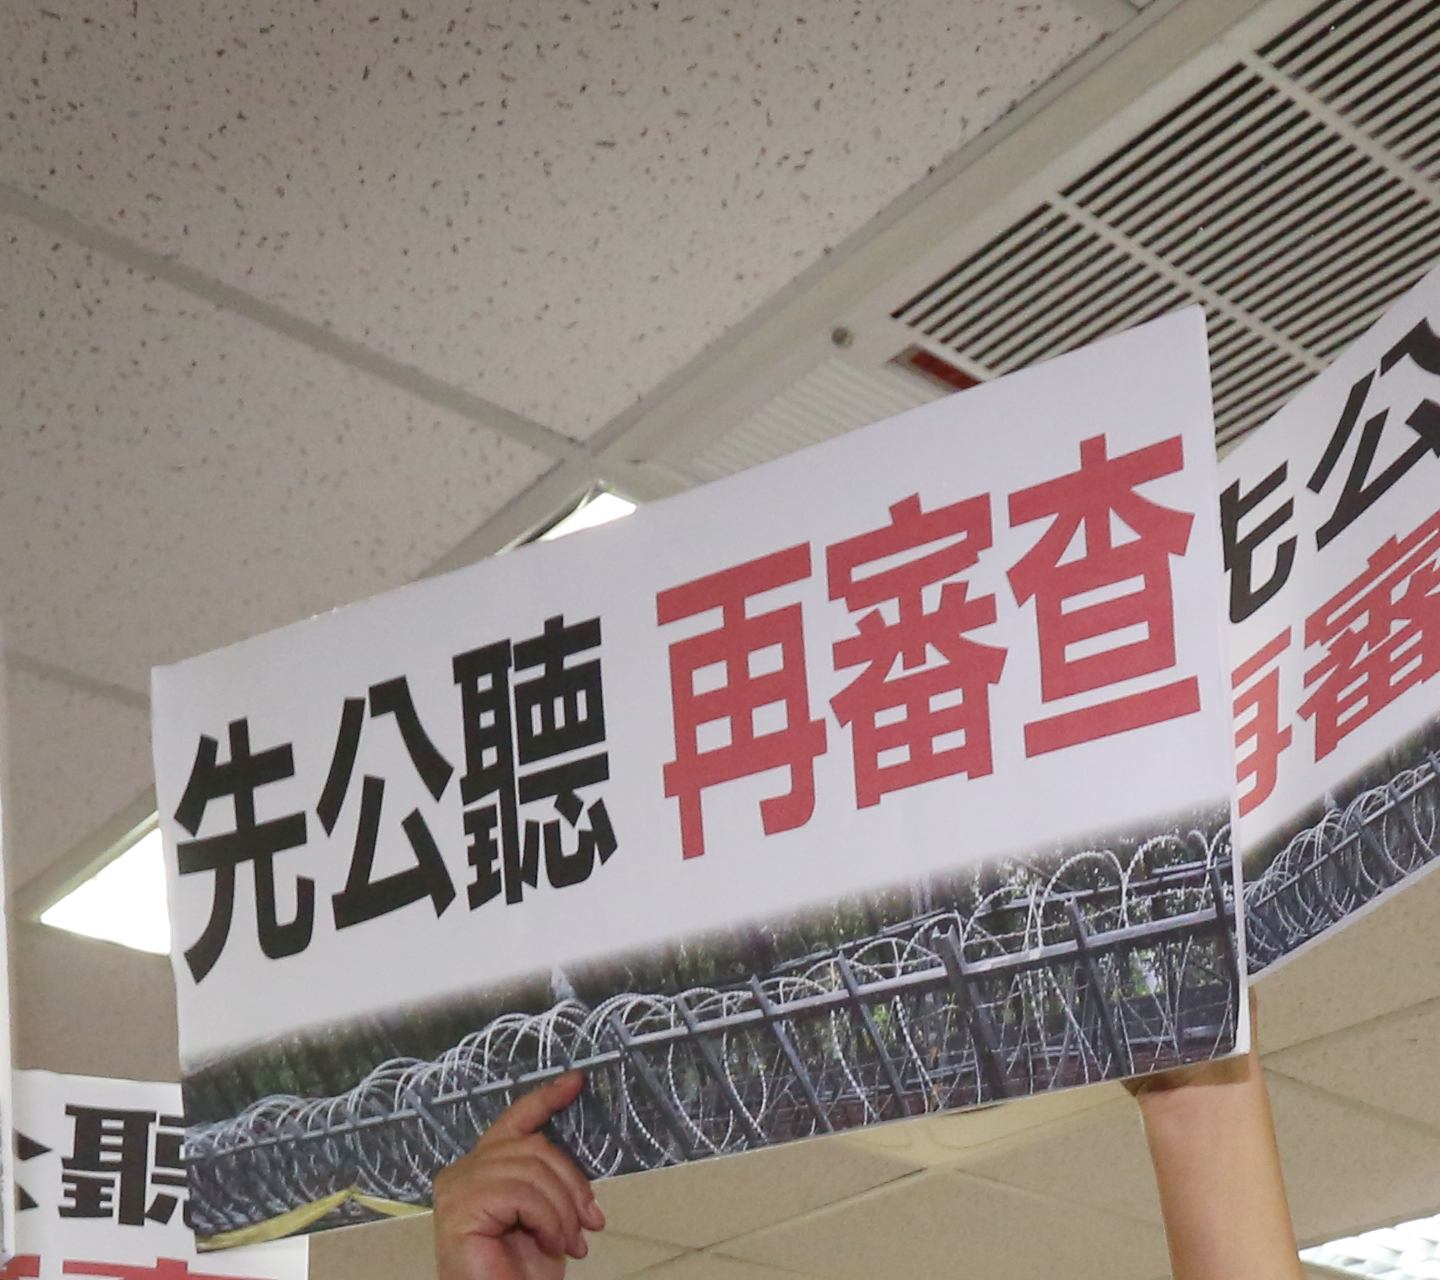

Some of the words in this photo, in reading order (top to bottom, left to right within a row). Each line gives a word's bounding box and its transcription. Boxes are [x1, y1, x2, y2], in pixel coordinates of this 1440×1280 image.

[173, 614, 618, 982] 先公聽
[656, 433, 1201, 861] 再審查
[17, 1103, 189, 1227] 聽
